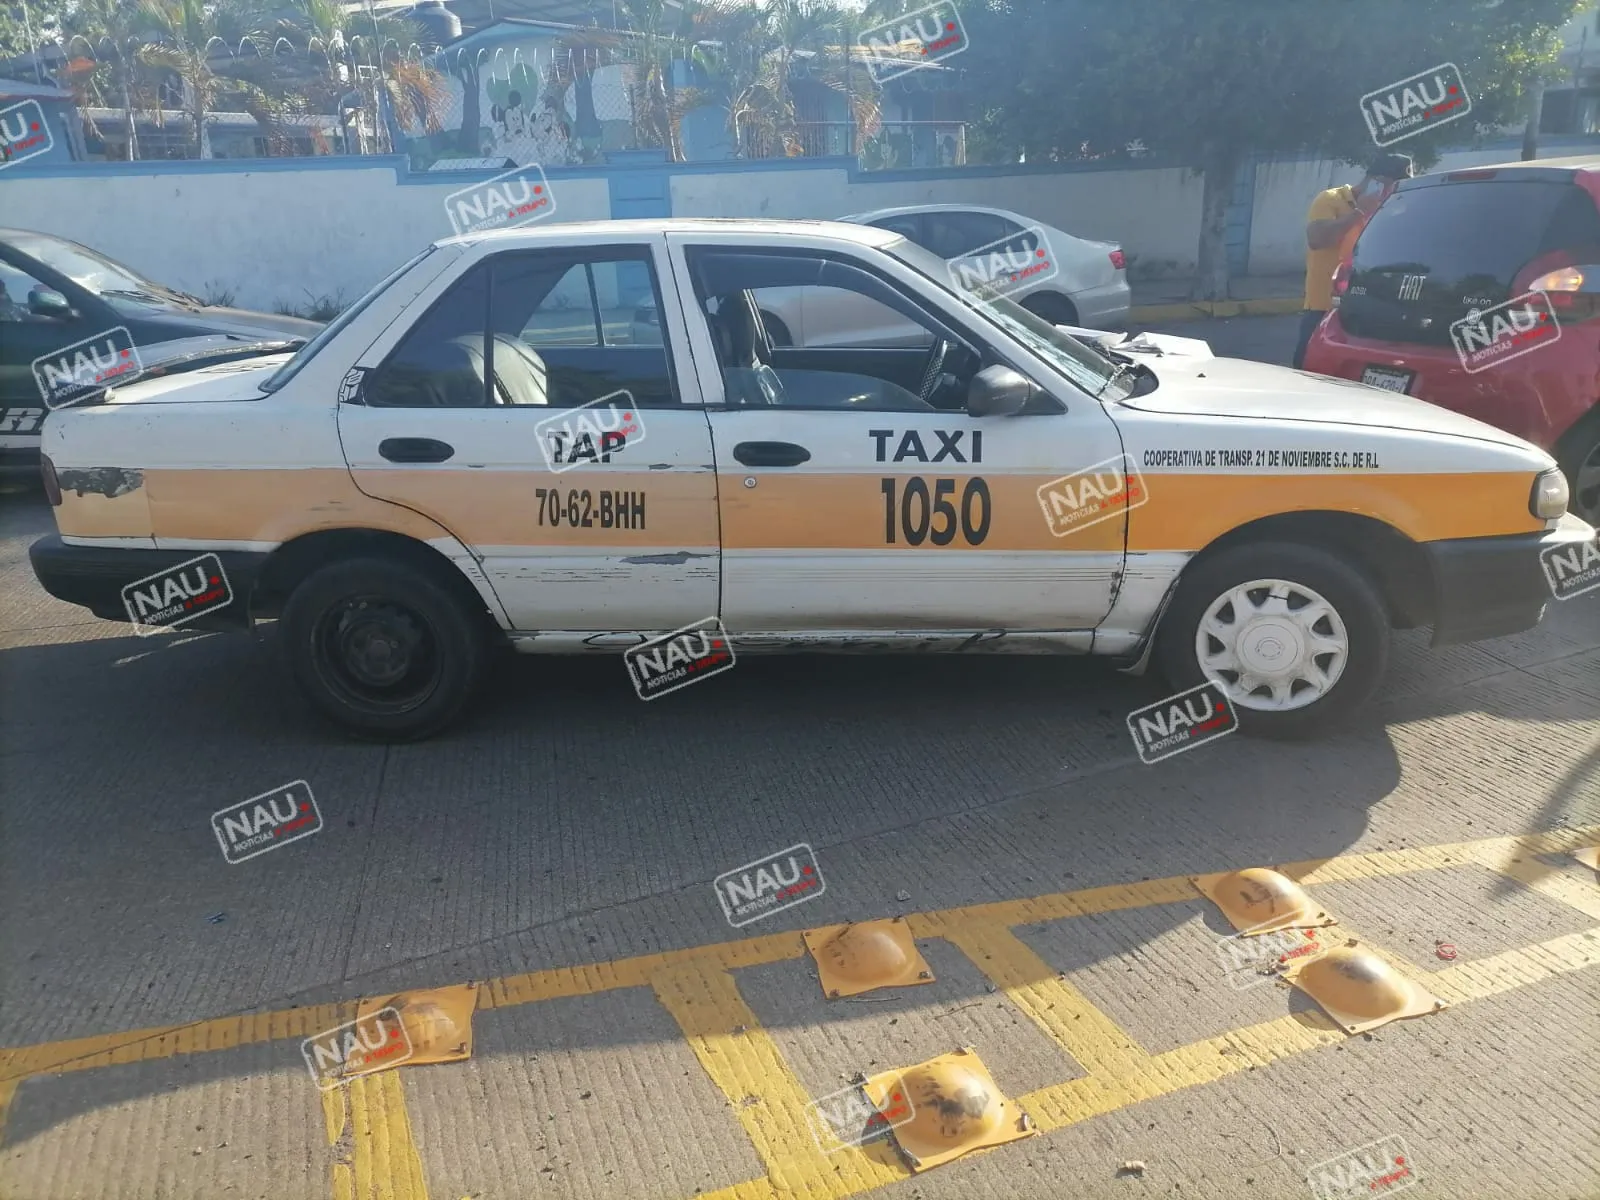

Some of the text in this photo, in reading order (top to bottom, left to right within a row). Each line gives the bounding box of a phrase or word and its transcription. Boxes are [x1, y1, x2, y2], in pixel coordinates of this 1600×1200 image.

[1398, 275, 1427, 300] FIAT
[548, 431, 626, 463] TAP
[869, 430, 982, 463] TAXI
[1143, 450, 1202, 466] COOPERATIVA
[1205, 450, 1216, 466] DE
[1218, 450, 1253, 466] TRANSP.
[1256, 451, 1265, 466] 21
[1268, 451, 1279, 466] DE
[1282, 451, 1331, 467] NOVIEMBRE
[1334, 452, 1350, 468] S.C.
[1353, 452, 1363, 468] DE
[536, 488, 646, 529] 70-62-BHH
[881, 476, 992, 546] 1050
